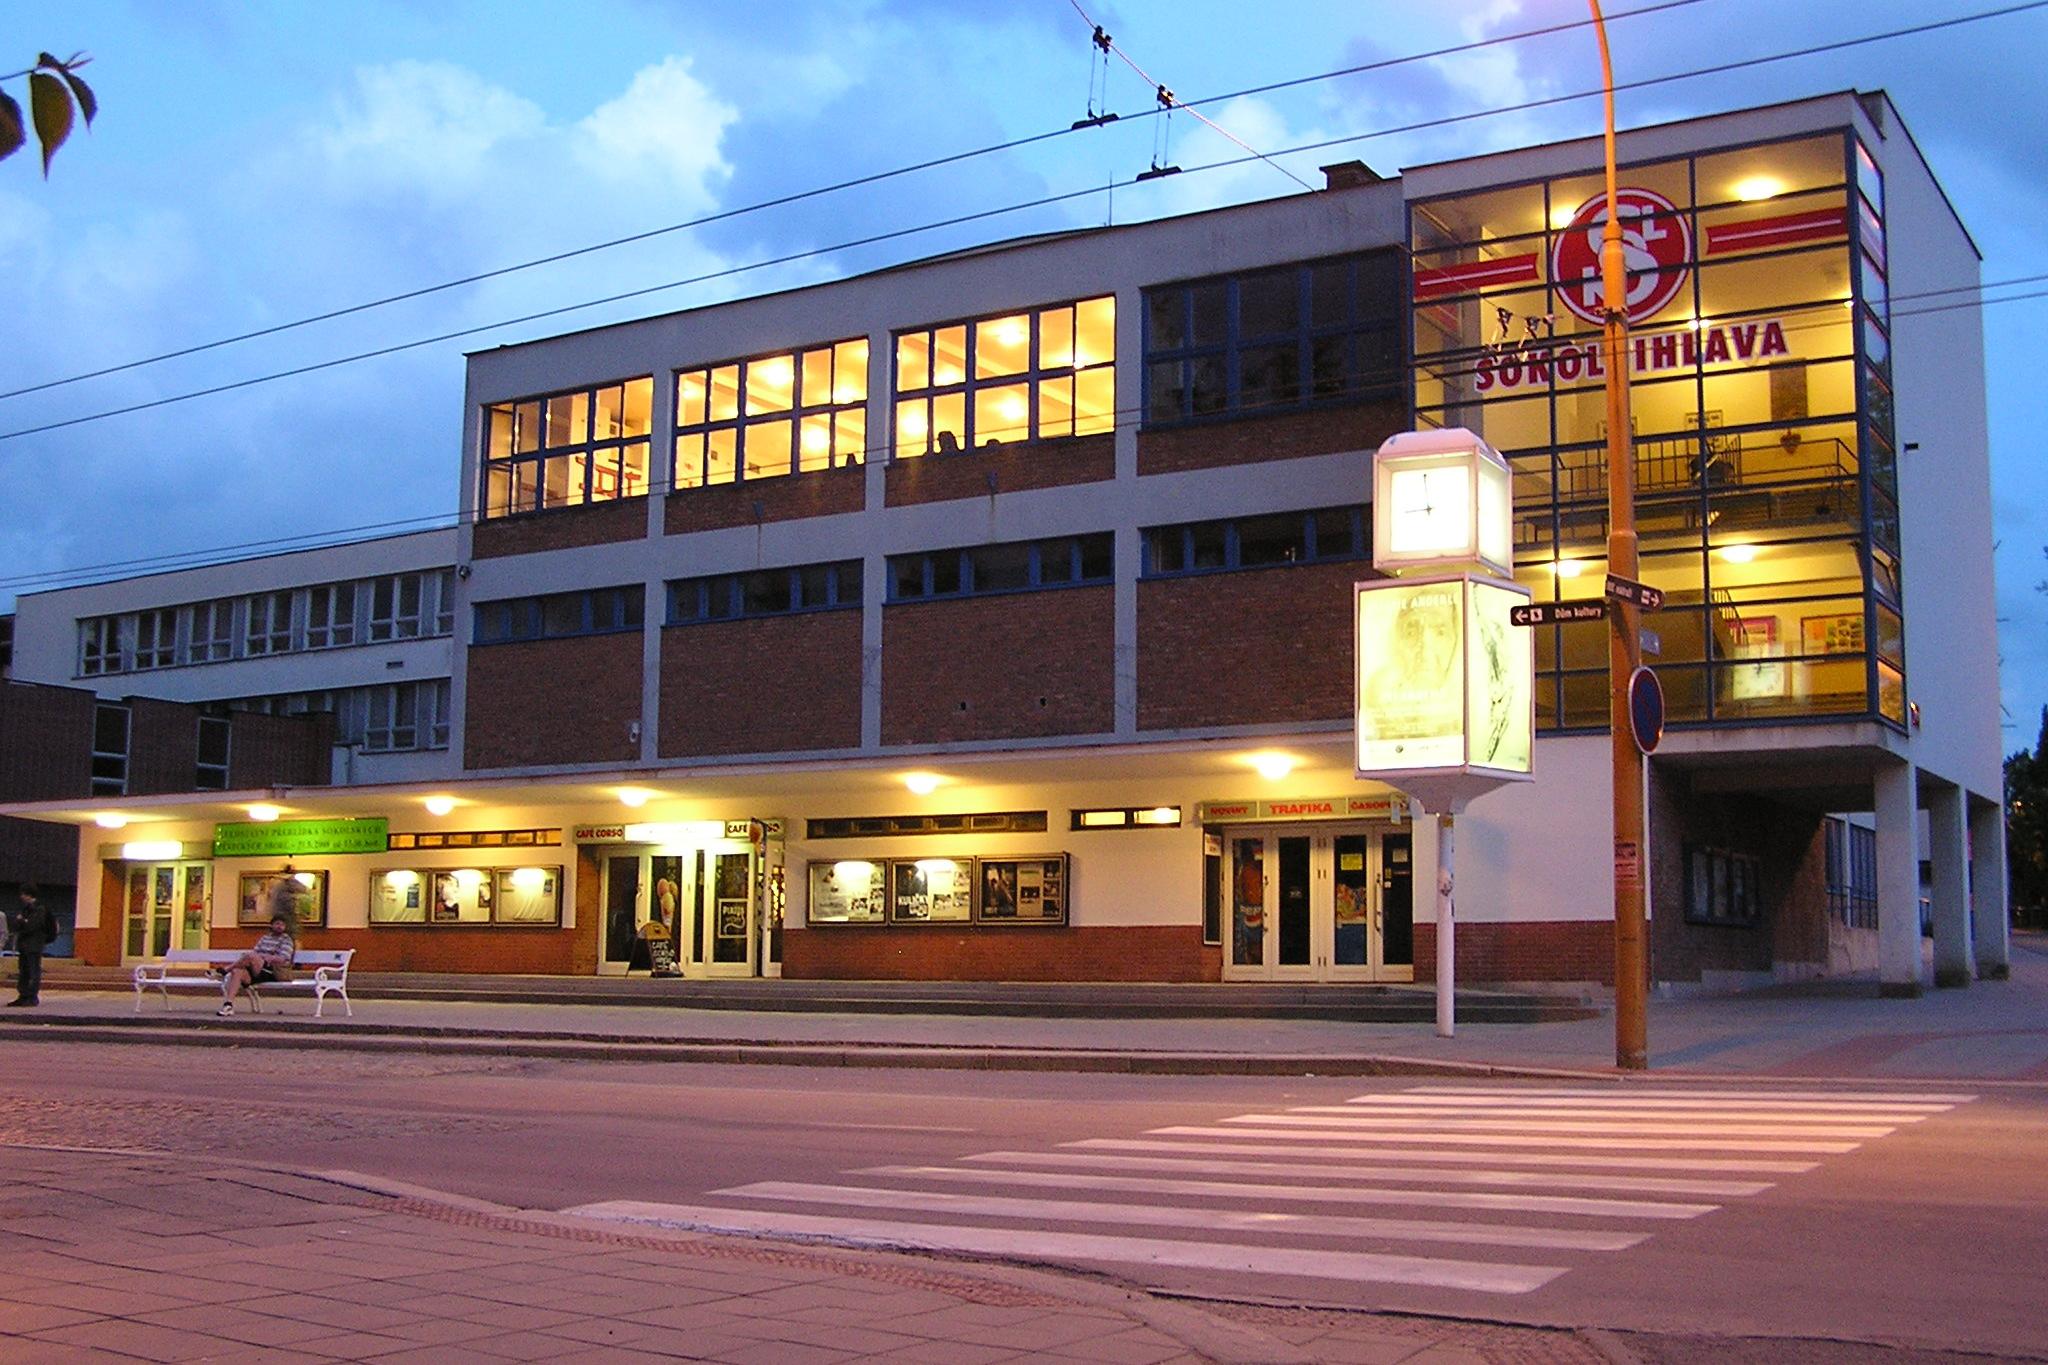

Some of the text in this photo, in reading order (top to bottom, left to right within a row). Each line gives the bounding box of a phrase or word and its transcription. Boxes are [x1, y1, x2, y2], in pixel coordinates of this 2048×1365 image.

[1476, 321, 1789, 391] SOKOL IHLAVA
[1270, 802, 1333, 815] TRAFIKA
[1350, 799, 1403, 810] ČASOPI
[596, 828, 624, 838] CORSO
